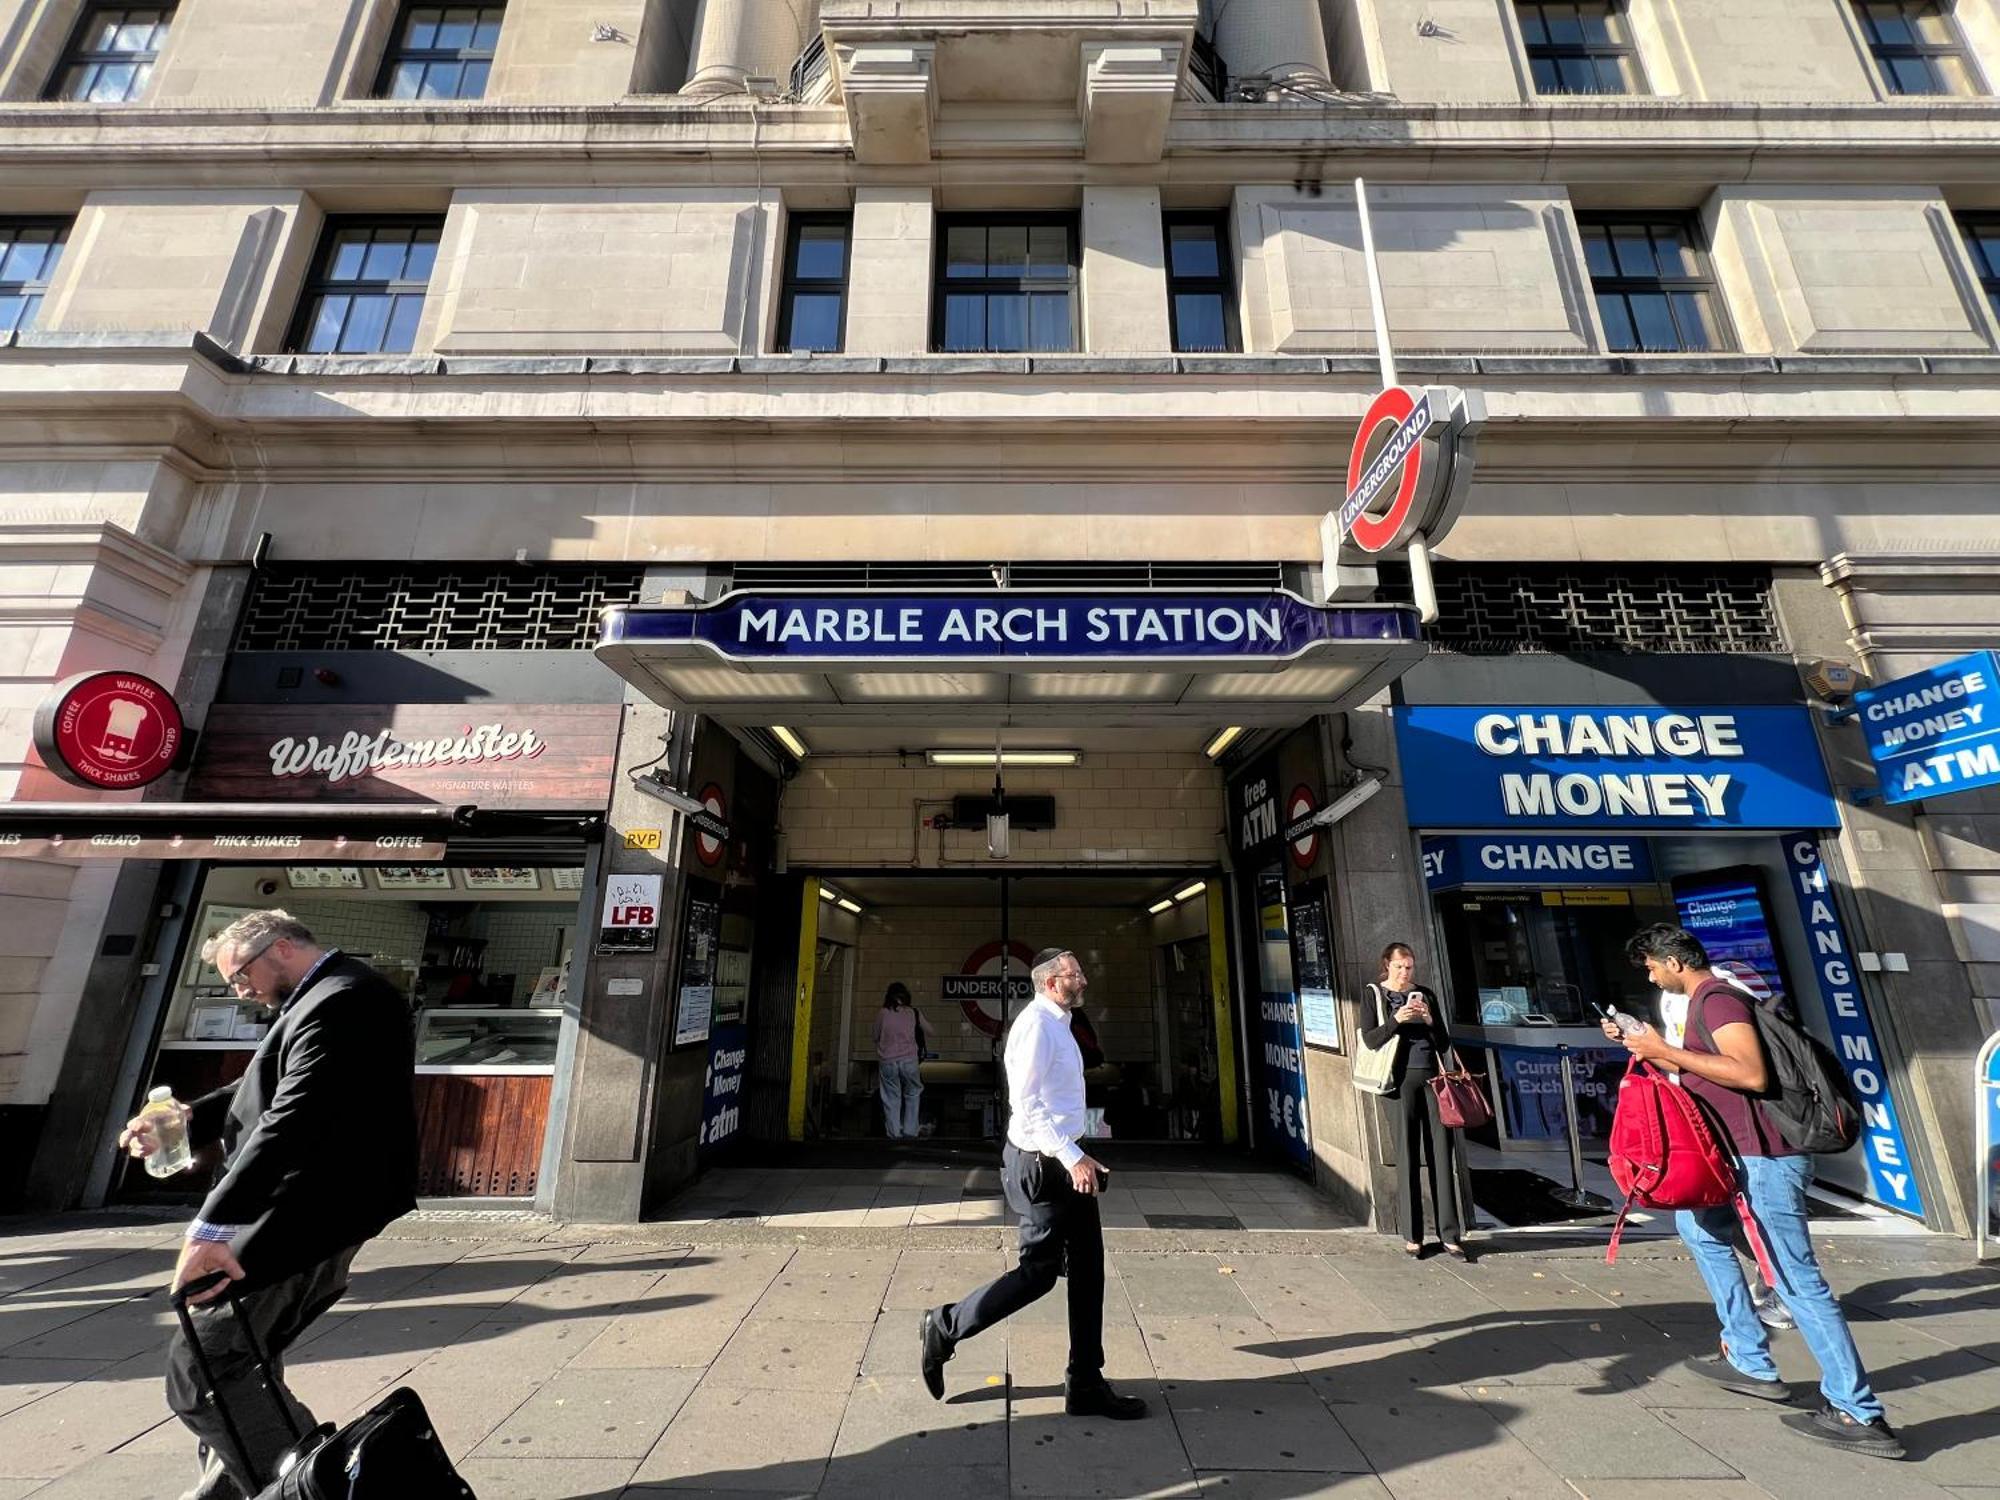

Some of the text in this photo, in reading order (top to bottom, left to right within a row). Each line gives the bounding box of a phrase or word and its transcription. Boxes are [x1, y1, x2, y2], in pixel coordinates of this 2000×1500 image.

[1343, 408, 1426, 523] UNDERGROUND
[738, 607, 1282, 643] MARBLE ARCH STATION
[116, 680, 156, 699] WAFFLES
[1867, 671, 1987, 721] CHANGE
[62, 700, 81, 734] COFFEE
[1882, 703, 1984, 747] MONEY
[160, 727, 176, 759] GELATO
[1474, 714, 1744, 756] CHANGE
[269, 723, 548, 784] Wafflemeister
[77, 759, 141, 783] THICK SHAKES
[1903, 744, 2000, 791] ATM
[1244, 778, 1267, 808] free
[1500, 773, 1732, 816] MONEY
[1242, 797, 1277, 850] ATM
[0, 833, 22, 845] LES
[91, 834, 141, 846] GELATO
[213, 835, 302, 848] THICK SHAKES
[375, 836, 423, 848] COFFEE
[627, 833, 657, 845] RVP
[1481, 844, 1634, 870] CHANGE
[611, 906, 654, 925] LFB
[1687, 900, 1737, 914] Change
[1690, 915, 1733, 928] Money
[946, 981, 1030, 995] UNDERRO
[1793, 841, 1908, 1201] CHANGE MONEY
[714, 1048, 745, 1071] Change
[713, 1073, 742, 1098] Money
[1519, 1080, 1607, 1097] Exchnge
[708, 1103, 739, 1144] atm
